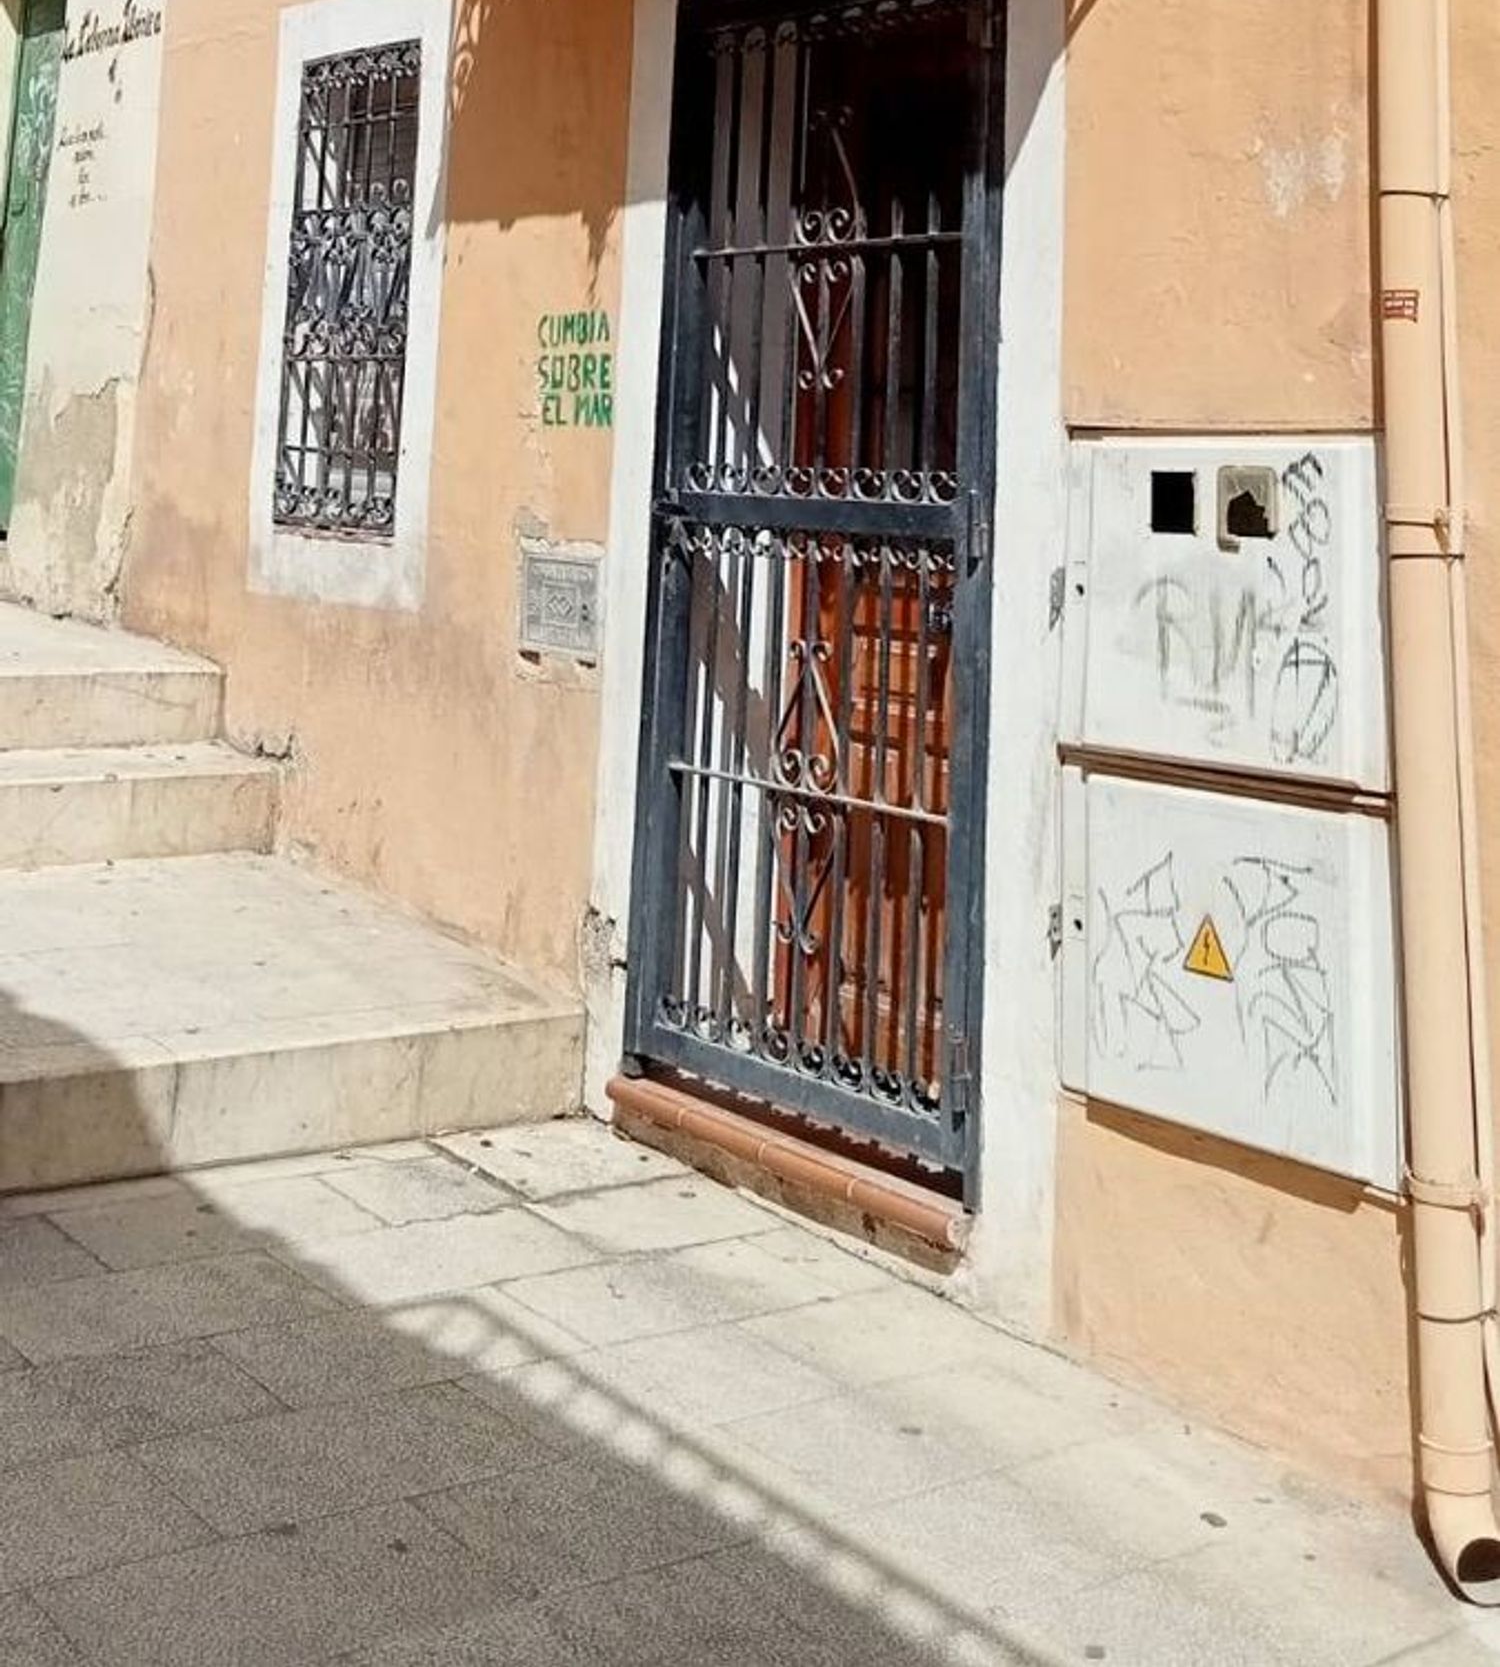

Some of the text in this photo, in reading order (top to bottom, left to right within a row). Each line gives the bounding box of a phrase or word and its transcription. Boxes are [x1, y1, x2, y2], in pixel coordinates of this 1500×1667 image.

[537, 310, 611, 348] CUMBIA
[537, 352, 612, 392] SOBRE
[542, 393, 613, 427] EL MAR
